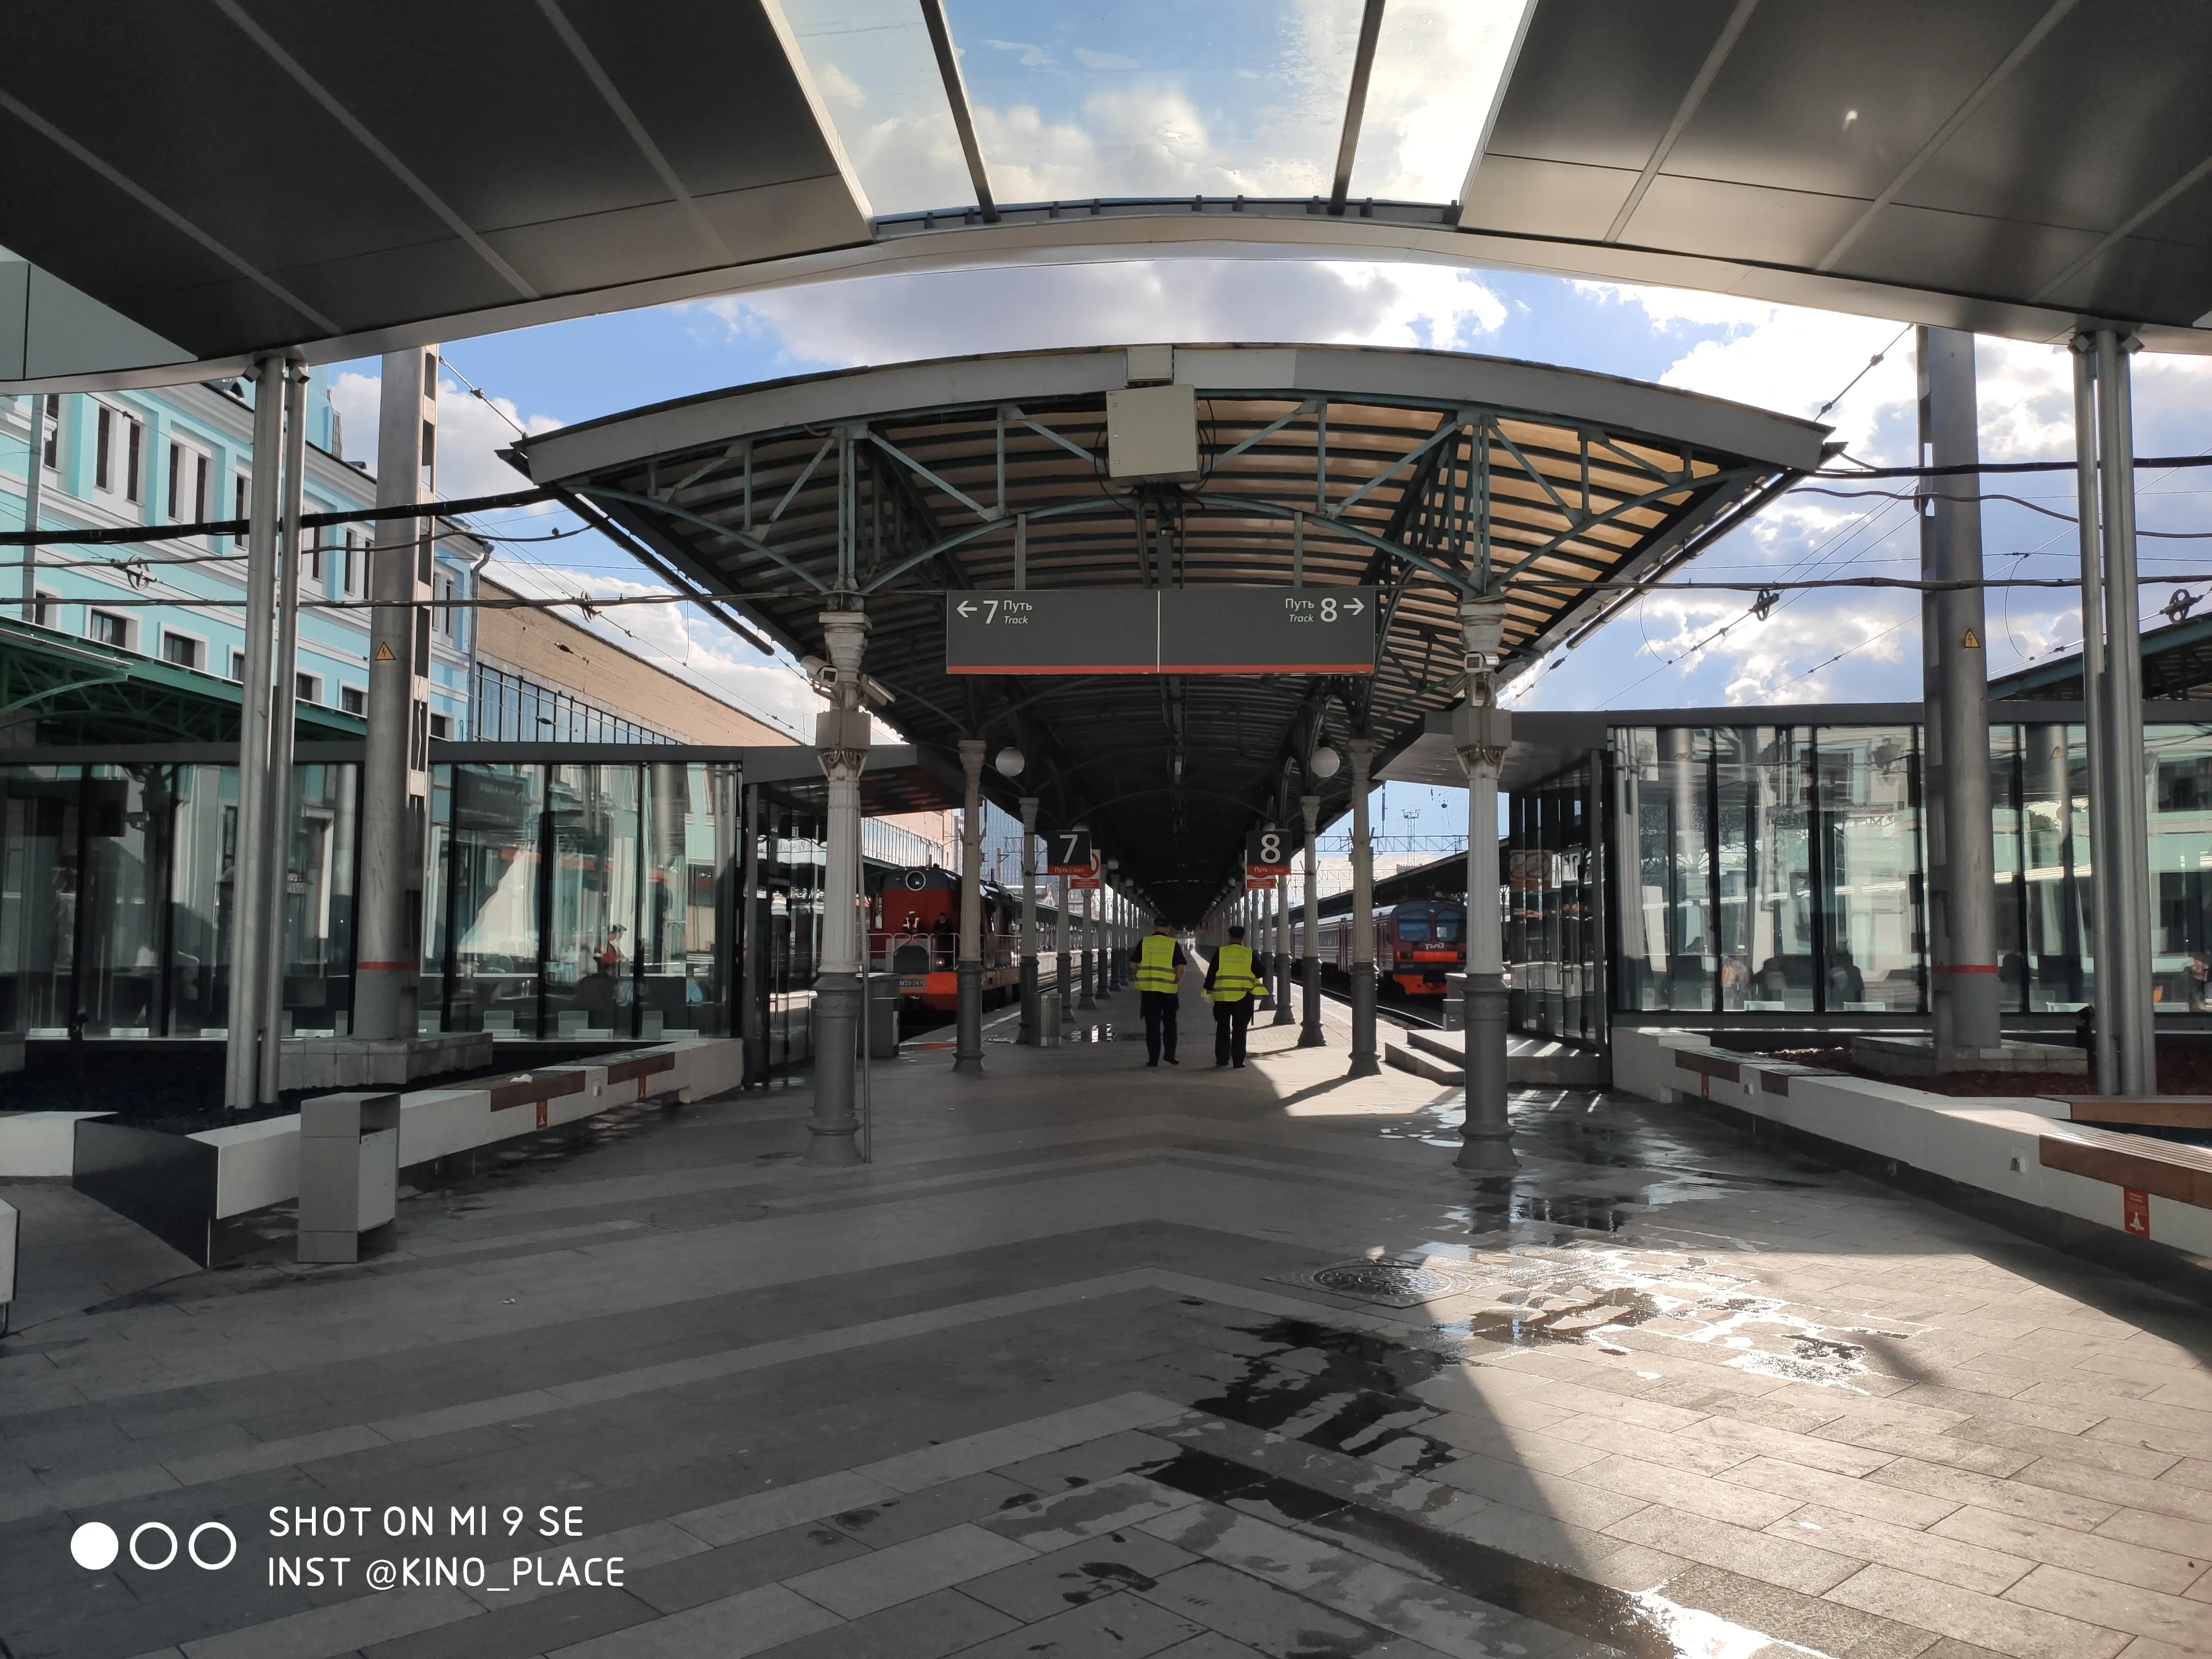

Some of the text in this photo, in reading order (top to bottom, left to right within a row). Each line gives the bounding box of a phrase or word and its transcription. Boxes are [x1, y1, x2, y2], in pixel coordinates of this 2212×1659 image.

[983, 600, 999, 624] 7
[1004, 600, 1032, 613] Путь
[1285, 598, 1314, 612] Путь
[1320, 597, 1338, 622] 8
[1004, 615, 1028, 624] Track
[1289, 613, 1314, 623] Track
[1060, 834, 1078, 863] 7
[1260, 833, 1281, 864] 8
